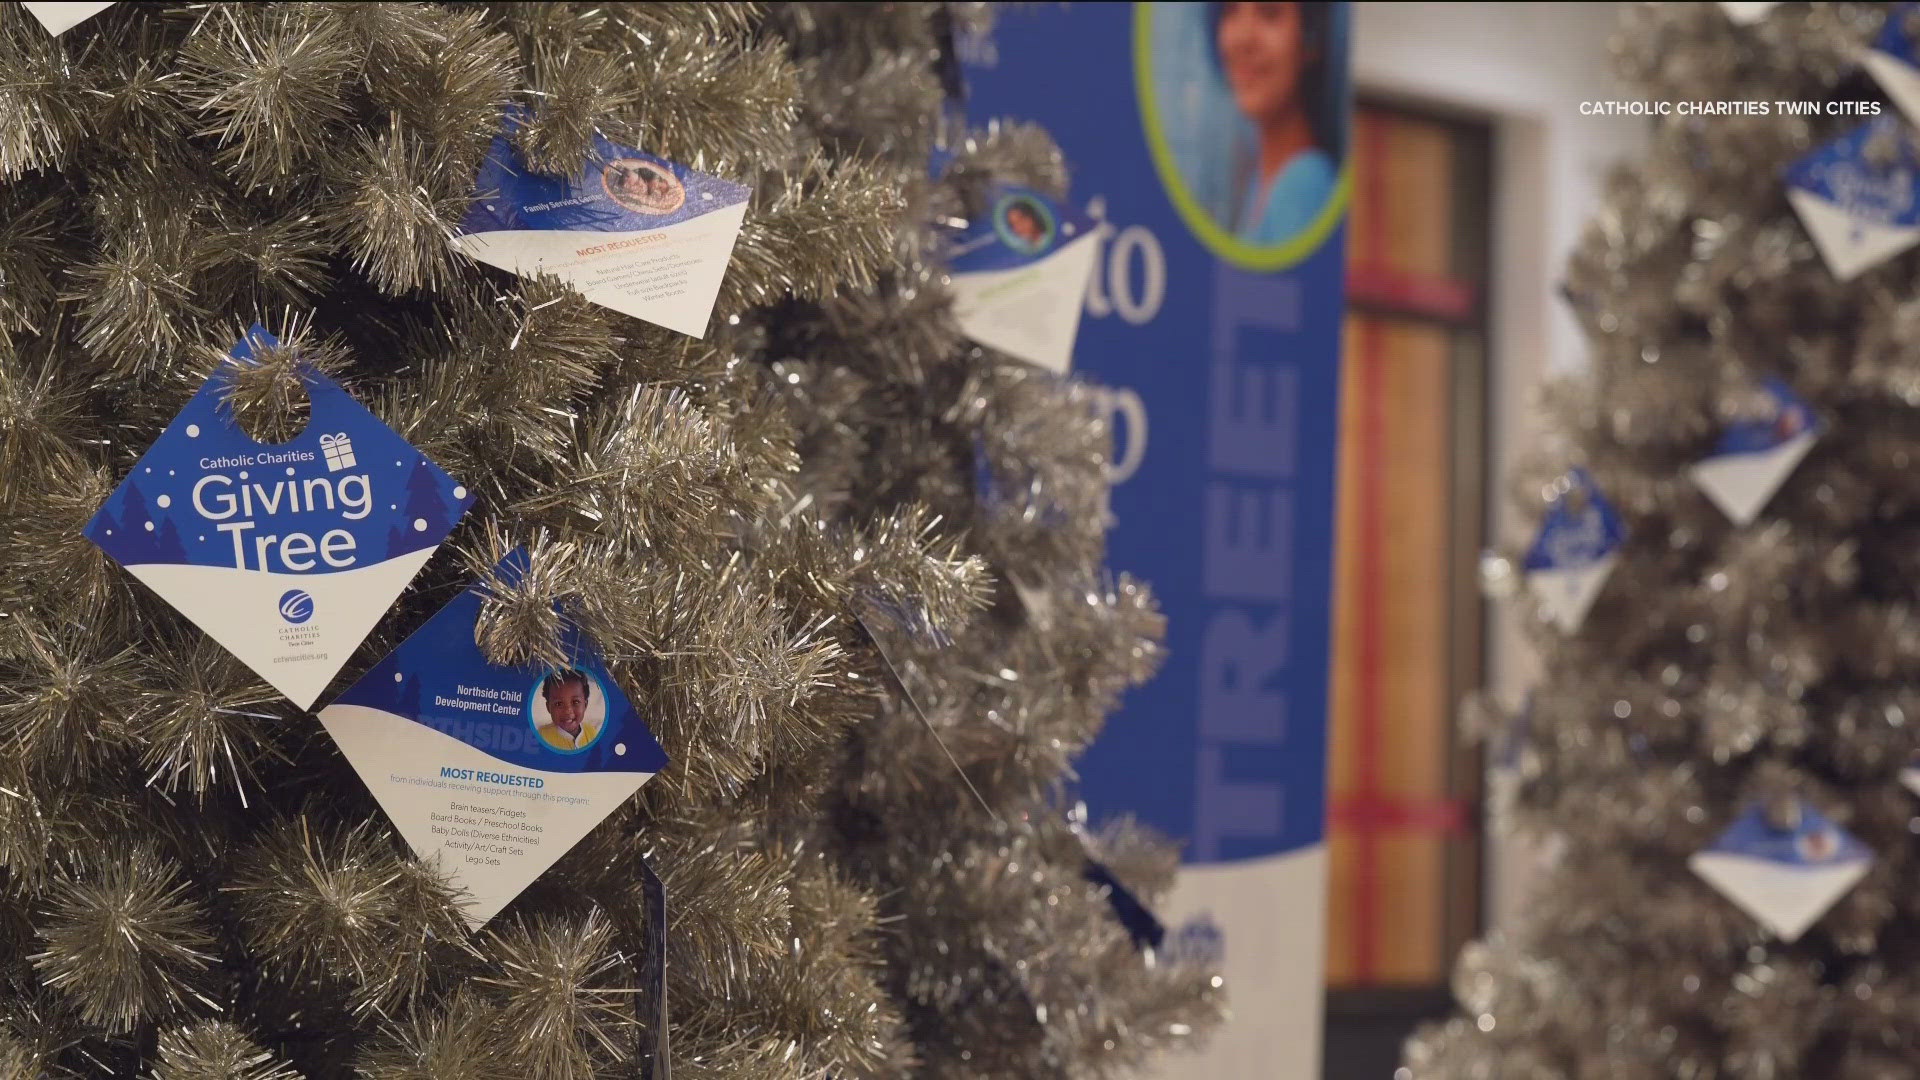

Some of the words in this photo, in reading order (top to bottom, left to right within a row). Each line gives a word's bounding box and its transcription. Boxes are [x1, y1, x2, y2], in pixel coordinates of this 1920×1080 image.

[523, 203, 550, 213] Family
[549, 198, 579, 208] Service
[576, 245, 607, 257] MOST
[608, 233, 667, 250] REQUESTED
[200, 454, 254, 469] Catholic
[257, 450, 315, 464] Charities
[192, 467, 372, 520] Giving
[217, 521, 357, 572] Tree
[279, 625, 320, 634] CATHOLIC
[280, 632, 321, 641] CHARITIES
[457, 685, 499, 699] Northside
[500, 690, 522, 702] Child
[435, 695, 491, 712] Development
[492, 703, 521, 716] Center
[390, 774, 408, 784] from
[408, 775, 448, 789] individuals
[448, 782, 481, 794] receiving
[483, 786, 512, 798] support
[512, 789, 542, 802] through
[542, 792, 556, 802] this
[440, 767, 475, 780] MOST
[476, 771, 544, 789] REQUESTED
[450, 801, 469, 812] Brain
[470, 804, 527, 819] teasers/Fidgets
[430, 812, 452, 823] Board
[454, 814, 477, 826] Books
[484, 817, 520, 830] Preschool
[521, 821, 544, 833] Books
[431, 825, 450, 837] Baby
[450, 827, 469, 838] Dolls
[470, 829, 500, 842] (Diverse
[501, 832, 540, 846] Ethnicities)
[444, 840, 508, 856] Activity/Art/Craft
[508, 846, 524, 856] Sets
[465, 855, 484, 866] Lego
[484, 856, 500, 866] Sets
